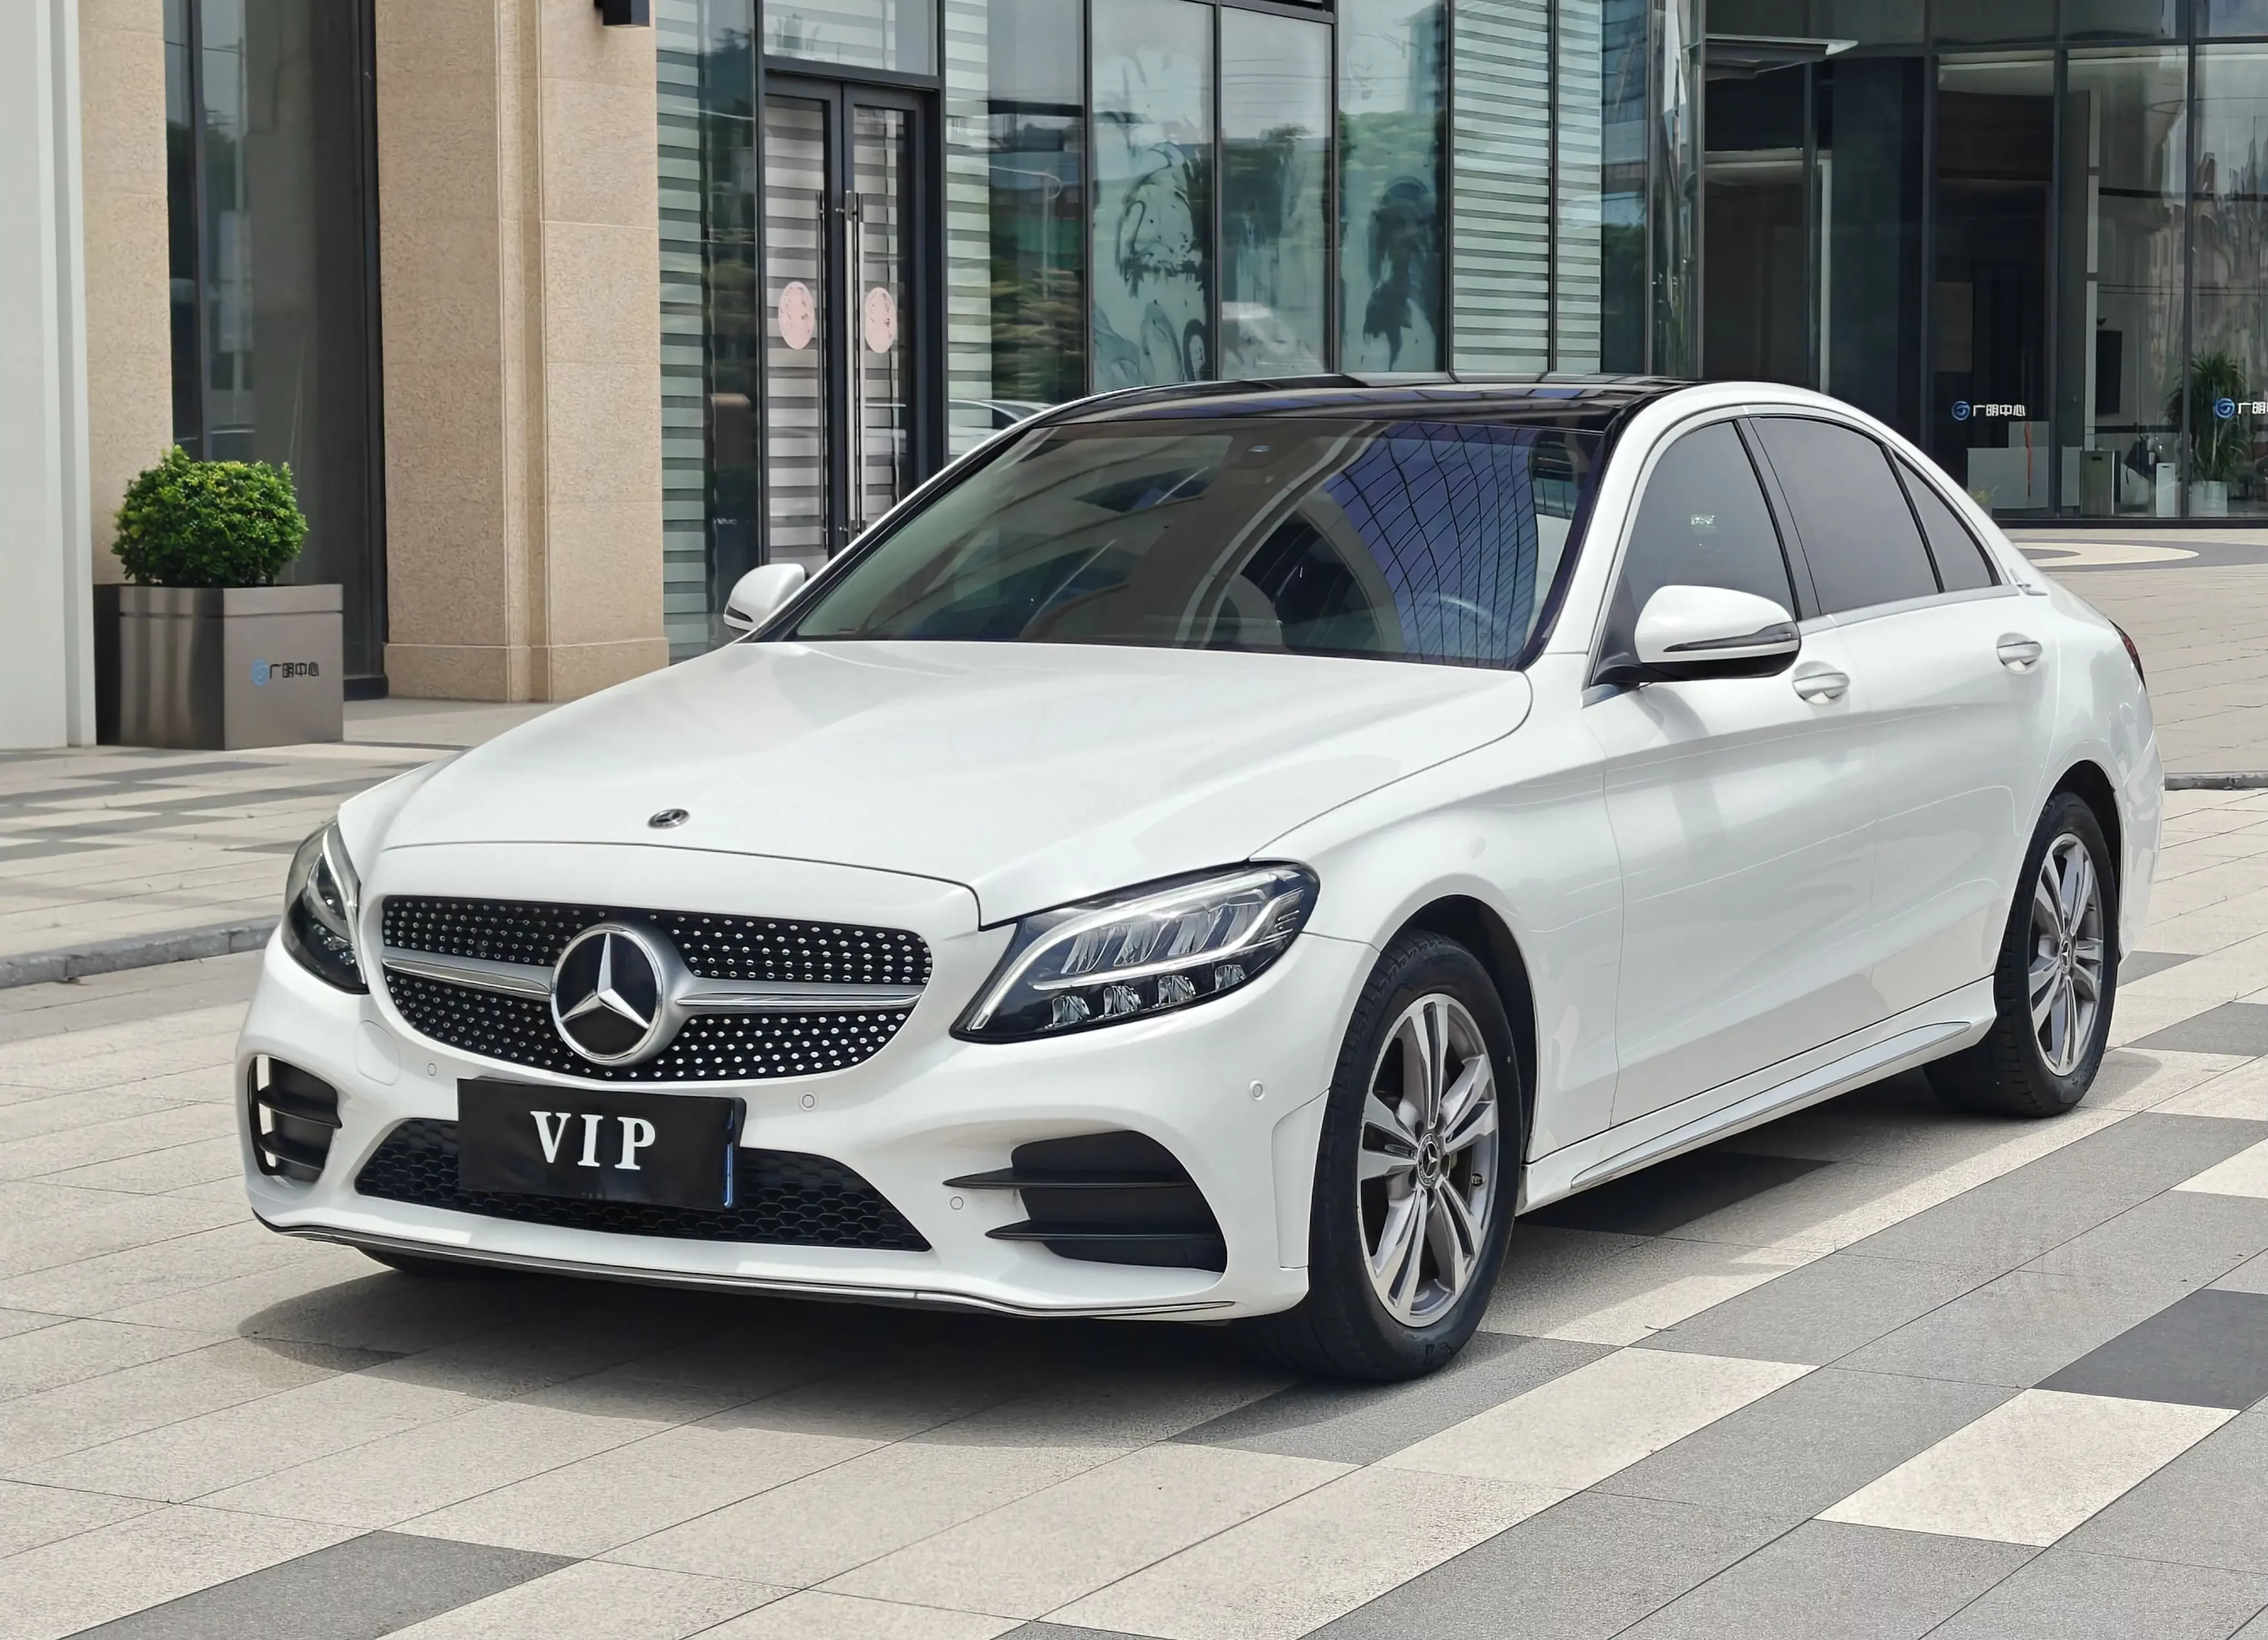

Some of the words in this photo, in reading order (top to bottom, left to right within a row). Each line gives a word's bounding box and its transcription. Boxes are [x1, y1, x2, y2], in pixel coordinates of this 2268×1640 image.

[1973, 404, 2026, 417] 广明中心
[2238, 402, 2268, 414] 广明
[530, 1111, 656, 1170] VIP
